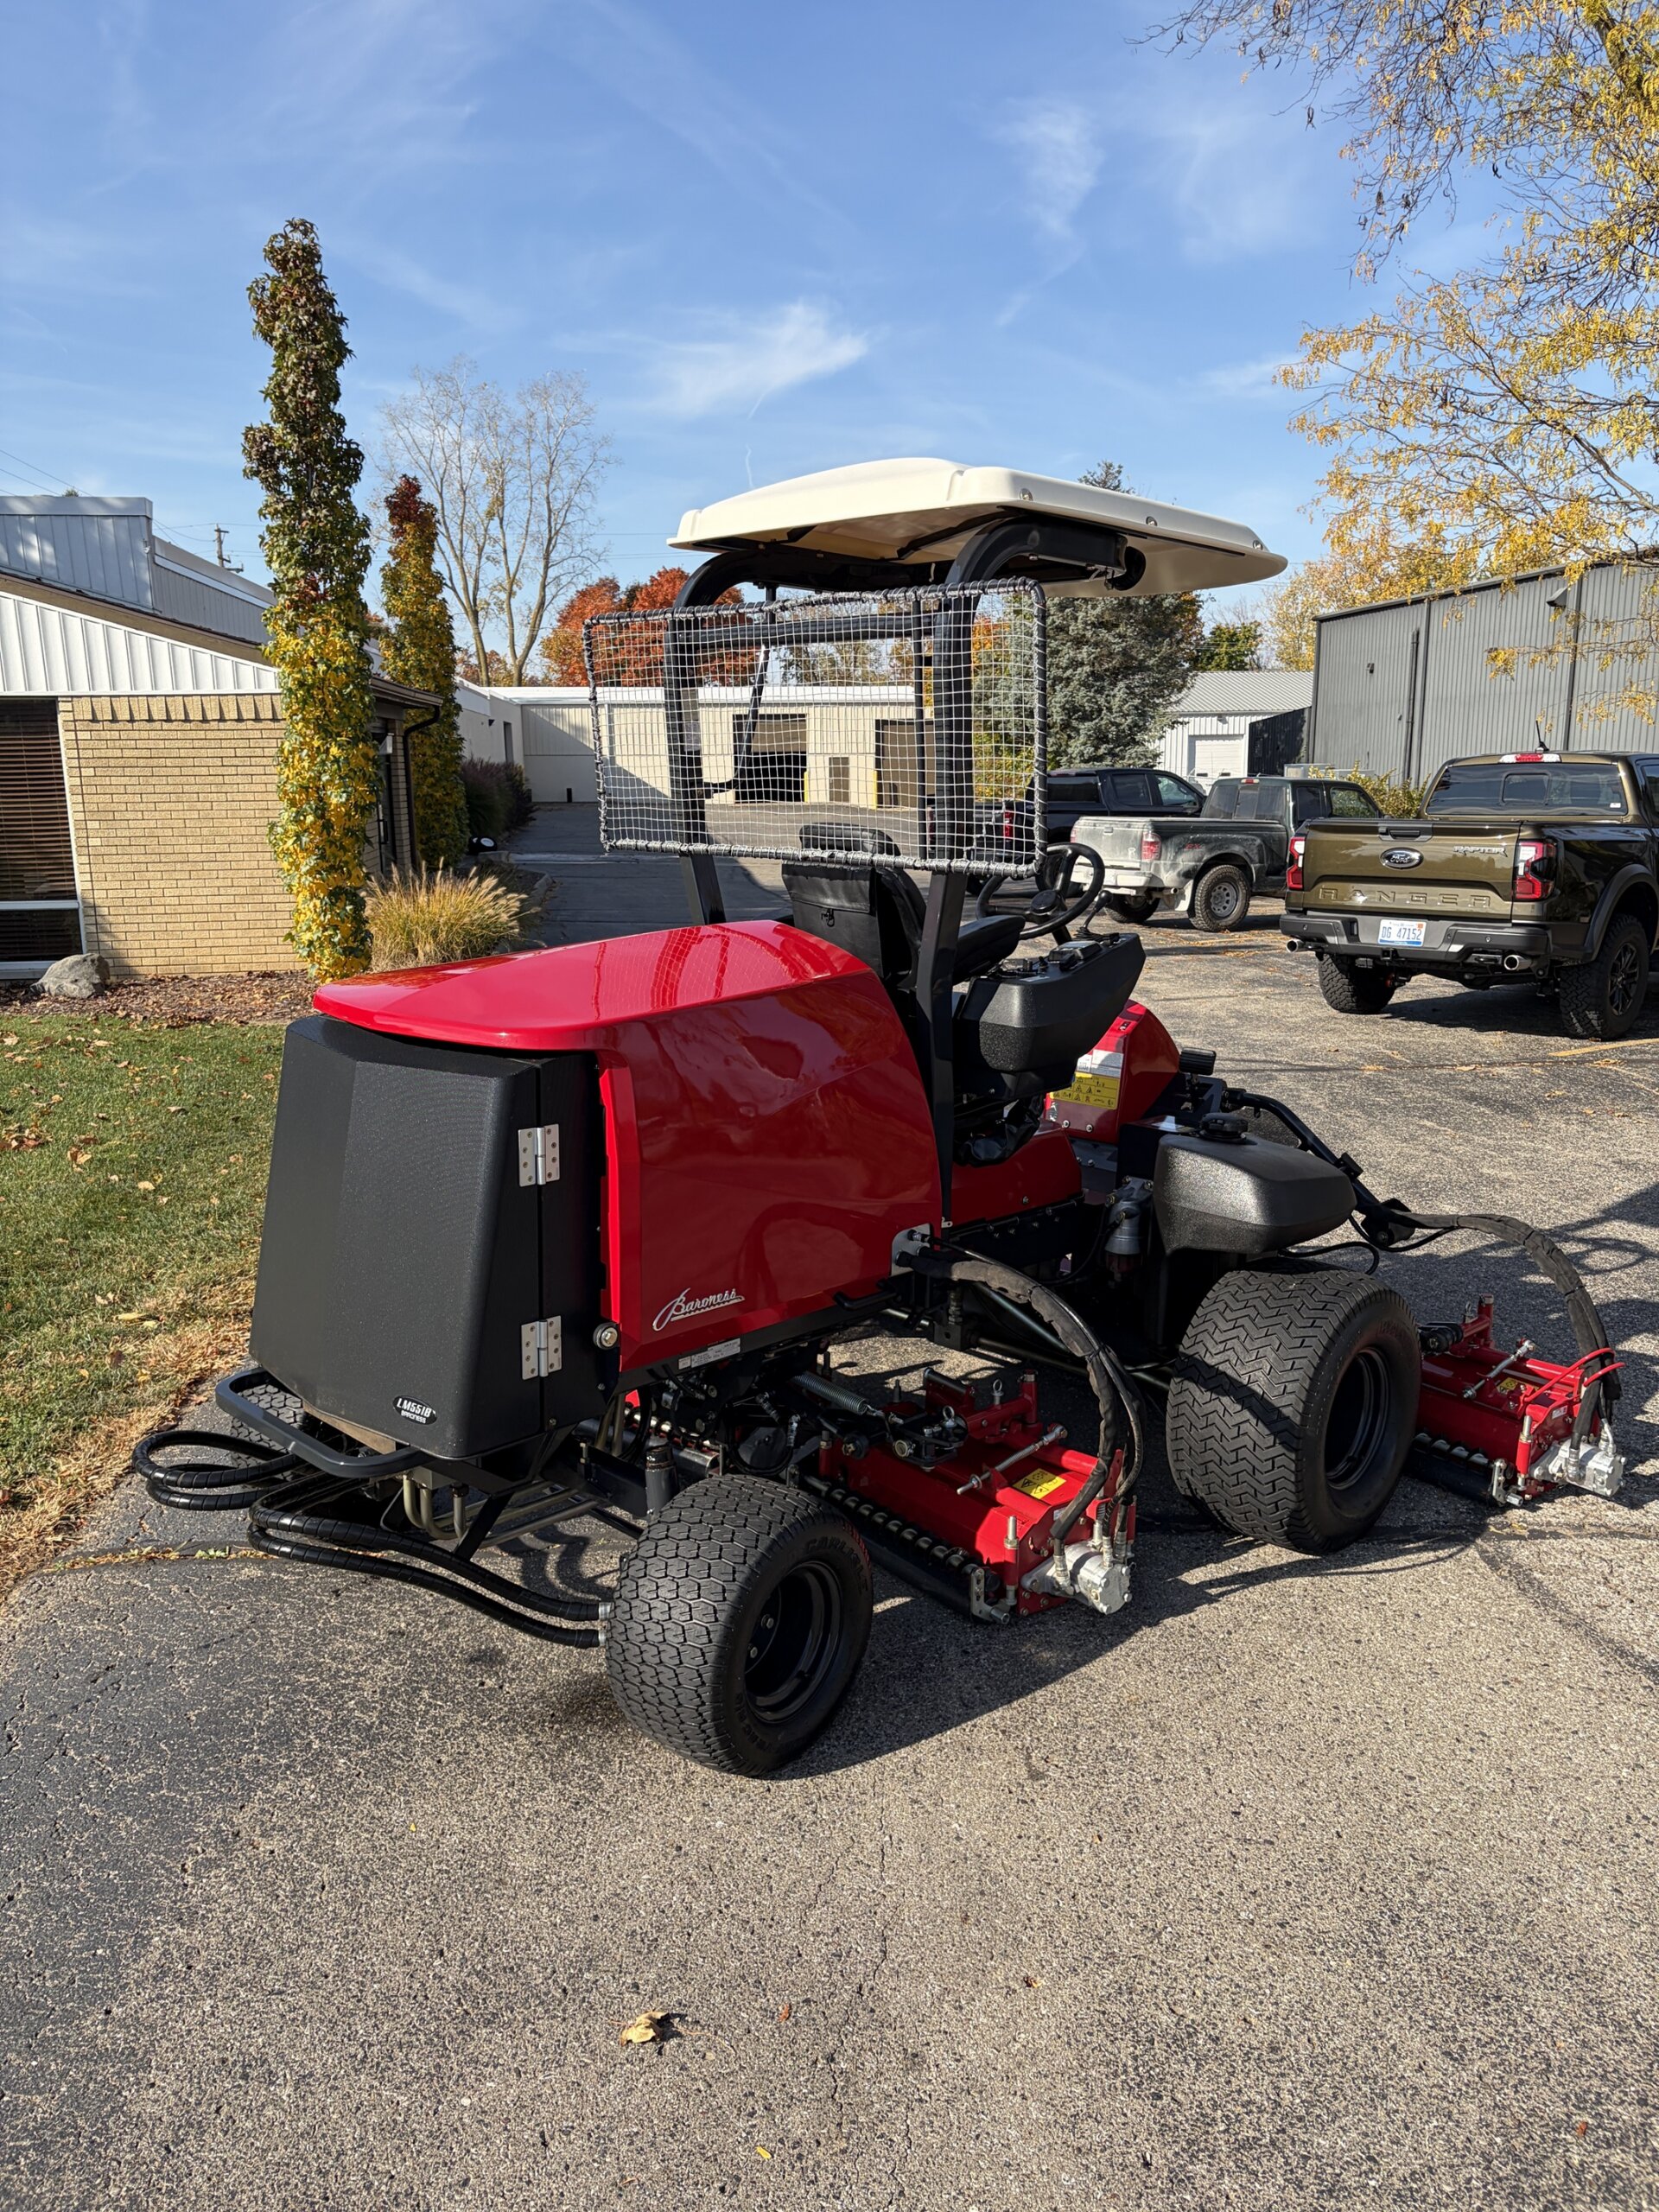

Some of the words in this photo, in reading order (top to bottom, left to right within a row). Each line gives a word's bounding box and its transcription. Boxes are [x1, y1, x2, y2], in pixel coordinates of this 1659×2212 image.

[1452, 846, 1509, 857] RAPTOR
[1319, 887, 1491, 909] RANGER
[1382, 926, 1392, 938] DG
[1396, 927, 1422, 940] 47152
[652, 1287, 745, 1332] Baroness
[401, 1409, 427, 1424] BARONESS
